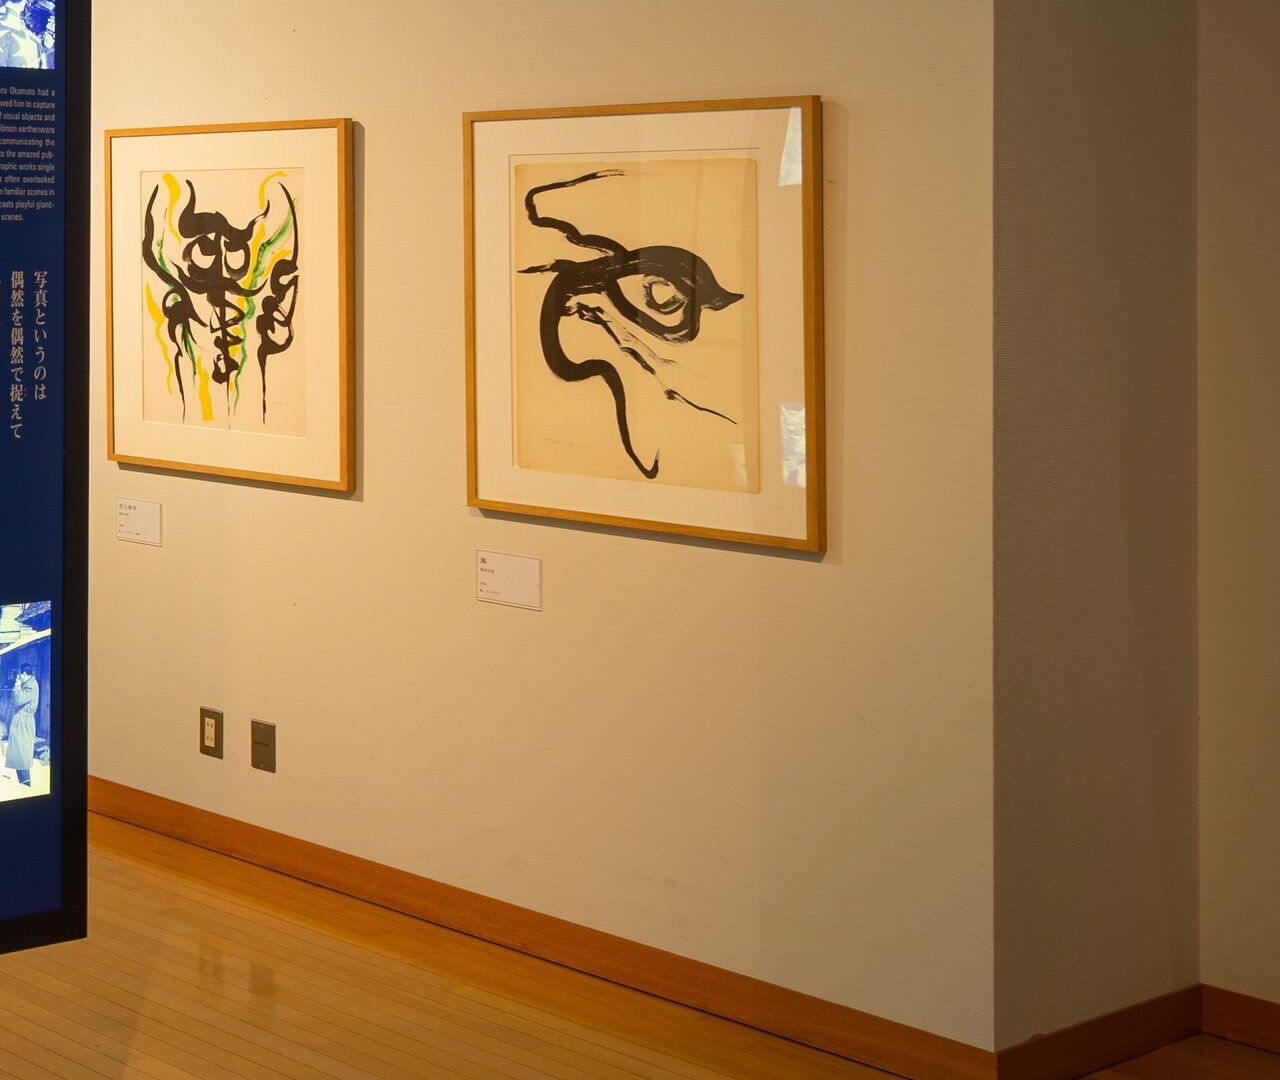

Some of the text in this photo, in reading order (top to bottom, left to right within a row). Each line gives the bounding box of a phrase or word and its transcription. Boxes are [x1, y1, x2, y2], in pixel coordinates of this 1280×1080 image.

[9, 86, 35, 95] Okamoto
[37, 87, 49, 96] had
[10, 270, 25, 439] 偶然を偶然で捉えて
[34, 270, 48, 400] 写真というのは
